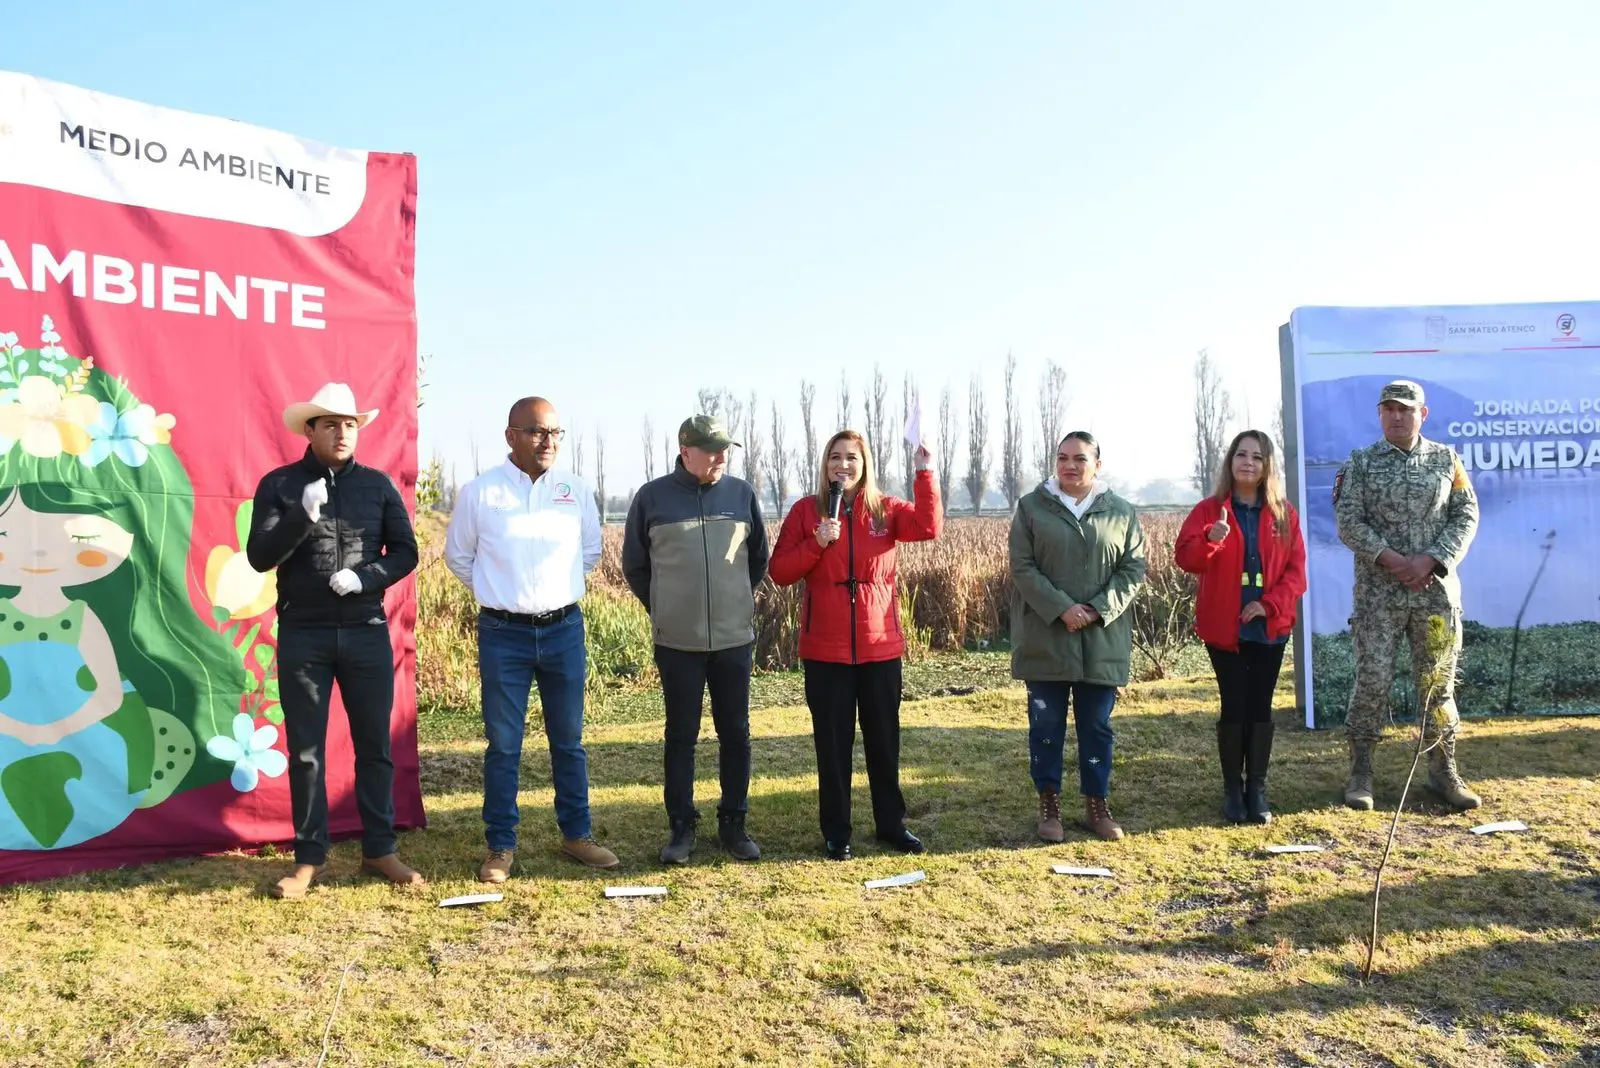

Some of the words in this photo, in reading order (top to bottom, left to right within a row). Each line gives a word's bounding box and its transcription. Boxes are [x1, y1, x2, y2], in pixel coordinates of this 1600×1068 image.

[60, 121, 168, 164] MEDIO
[178, 147, 331, 196] AMBIENTE
[1448, 326, 1466, 335] SAN
[1467, 325, 1499, 334] MATEO
[1500, 324, 1536, 333] ATENCO
[1473, 399, 1574, 417] JORNADA
